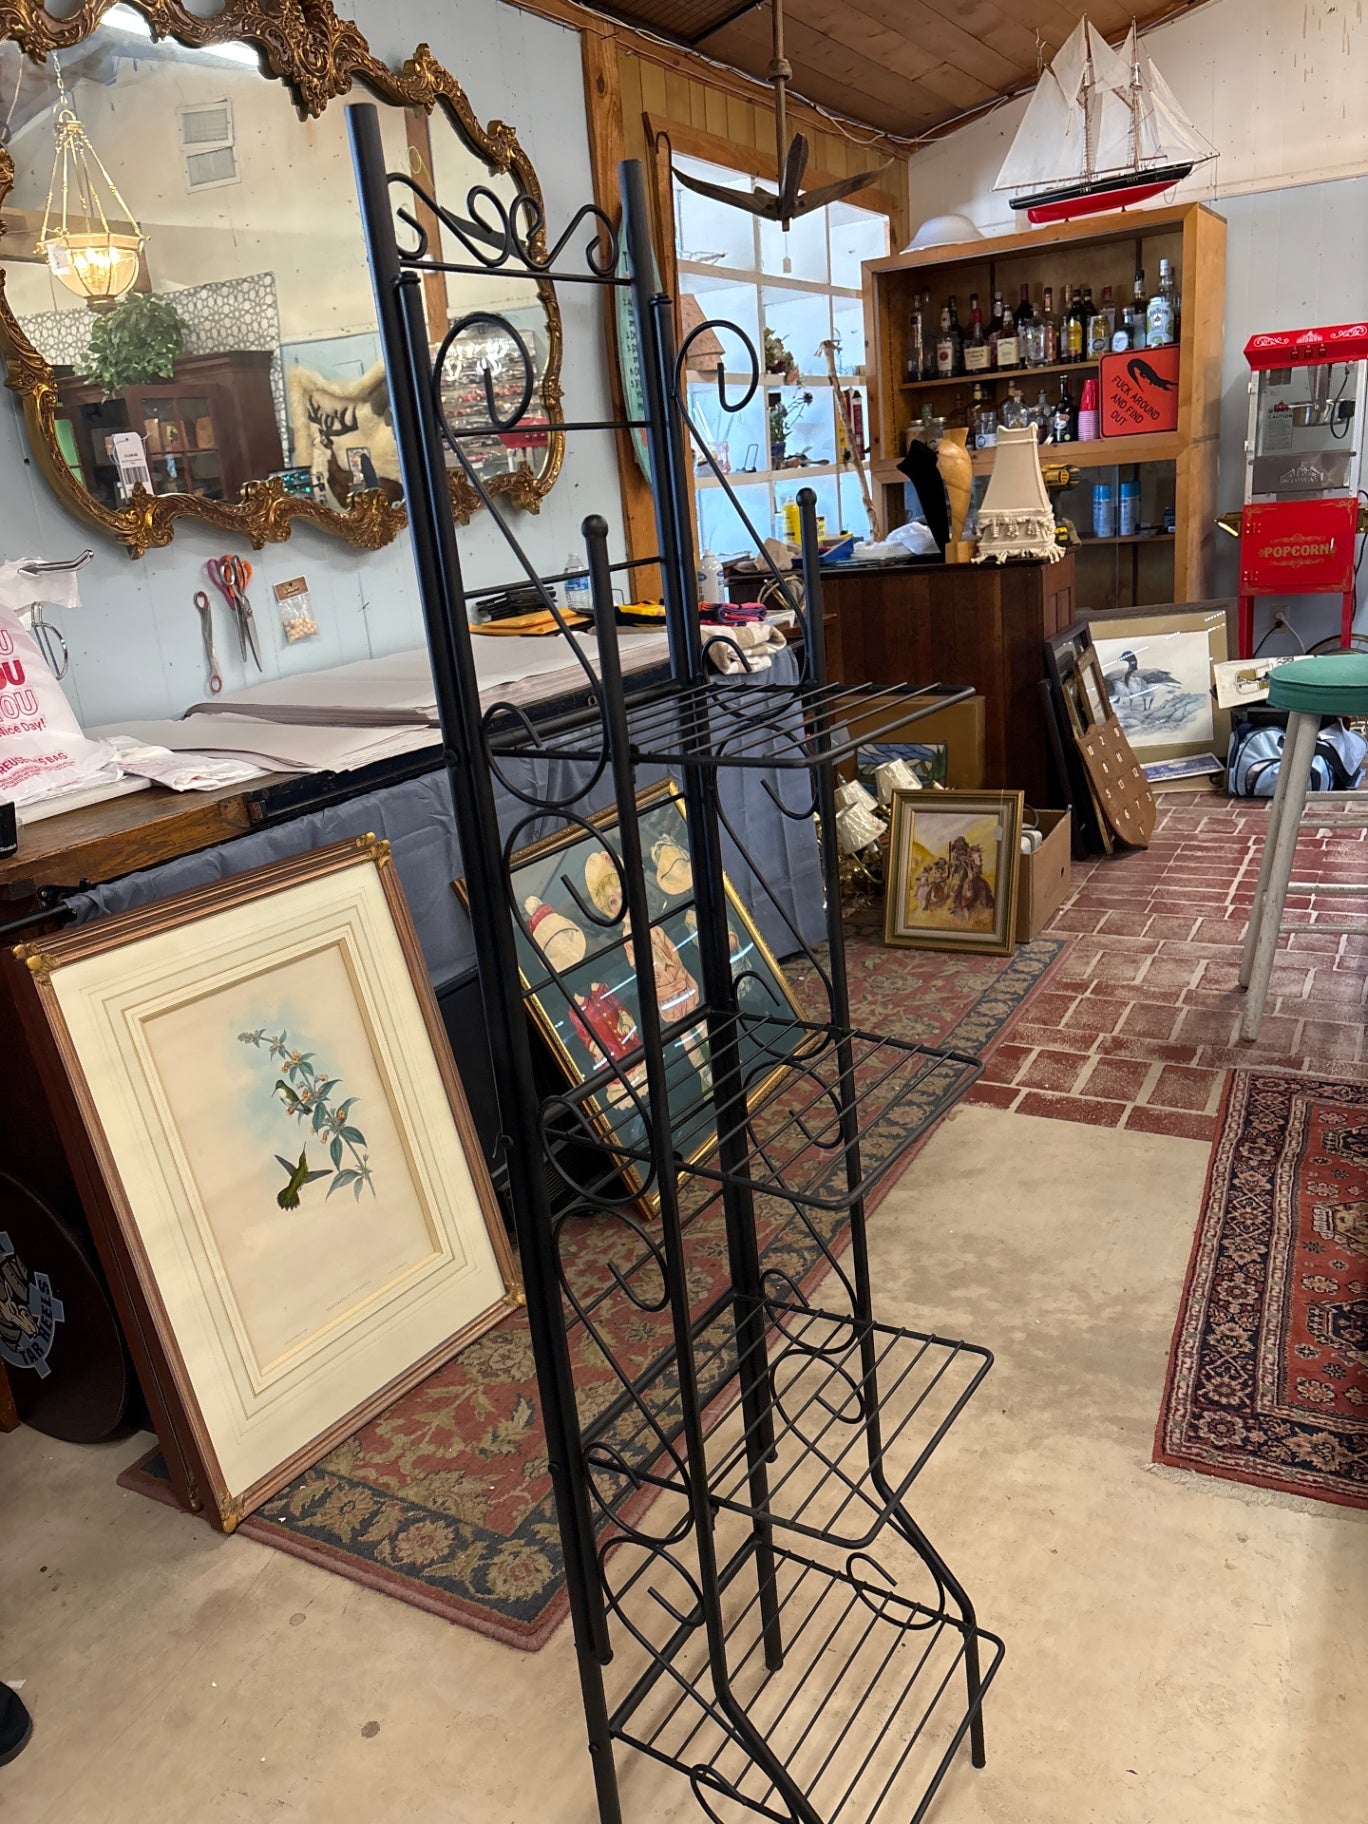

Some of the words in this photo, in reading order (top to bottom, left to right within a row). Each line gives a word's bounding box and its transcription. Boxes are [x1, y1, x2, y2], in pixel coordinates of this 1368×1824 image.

[1110, 393, 1128, 410] AND
[1125, 405, 1144, 423] FIND
[1112, 375, 1132, 395] FUCK
[1130, 393, 1160, 420] AROUND
[1110, 410, 1127, 426] OUT
[1264, 544, 1330, 557] POPCORN
[20, 718, 47, 732] Day!
[20, 1342, 45, 1365] TAR
[38, 1279, 53, 1341] HEELS
